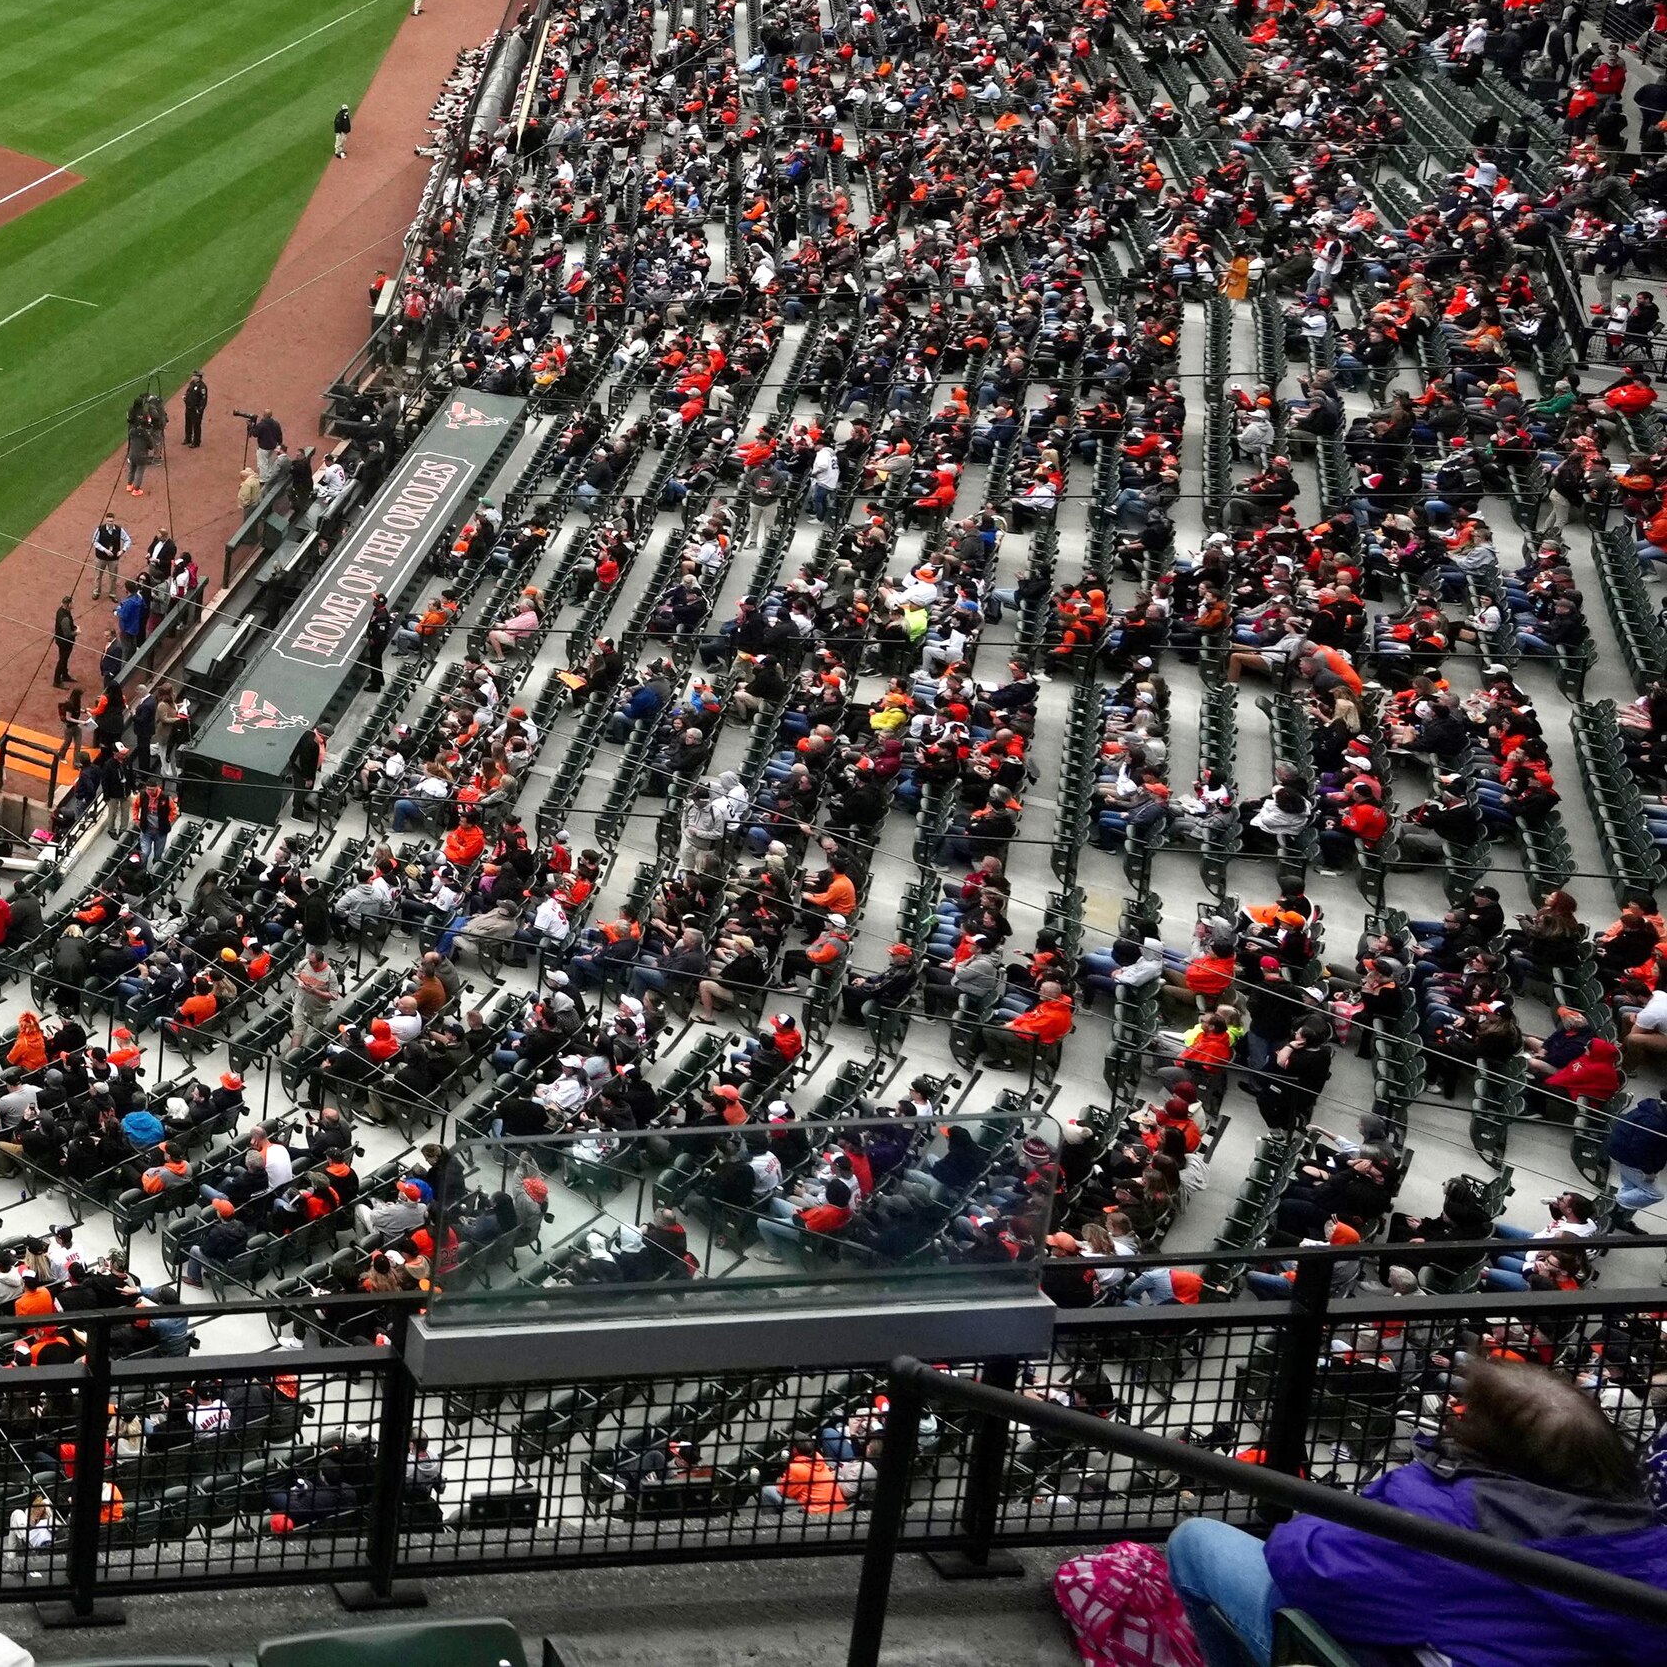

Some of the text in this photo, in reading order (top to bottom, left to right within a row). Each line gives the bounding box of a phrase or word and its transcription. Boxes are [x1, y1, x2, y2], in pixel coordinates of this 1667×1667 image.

[291, 460, 459, 657] HOME OF THE ORIOLES
[65, 1252, 80, 1263] MAYS
